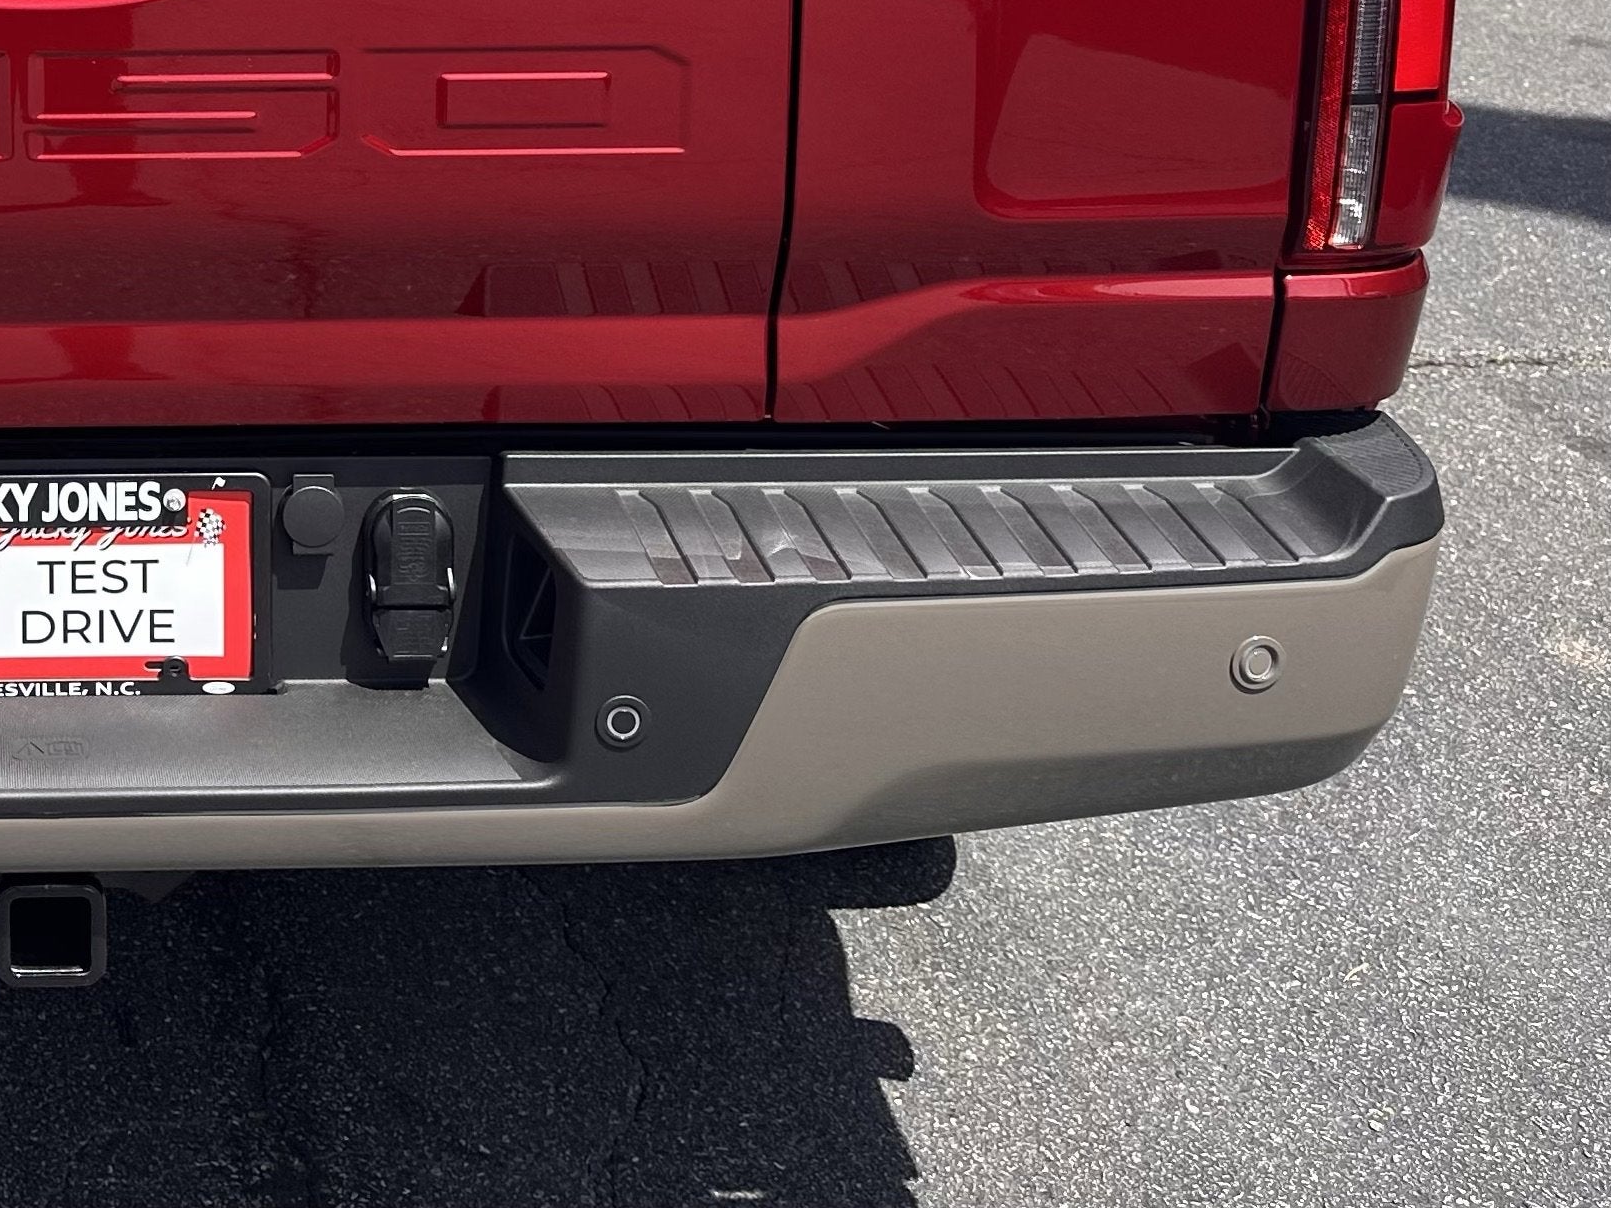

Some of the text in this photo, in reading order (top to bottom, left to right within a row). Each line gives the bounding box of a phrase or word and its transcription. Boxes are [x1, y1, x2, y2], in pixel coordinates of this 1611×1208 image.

[42, 481, 161, 522] JONES
[37, 559, 159, 594] TEST
[22, 609, 175, 644] DRIVE
[95, 681, 141, 696] N.C.
